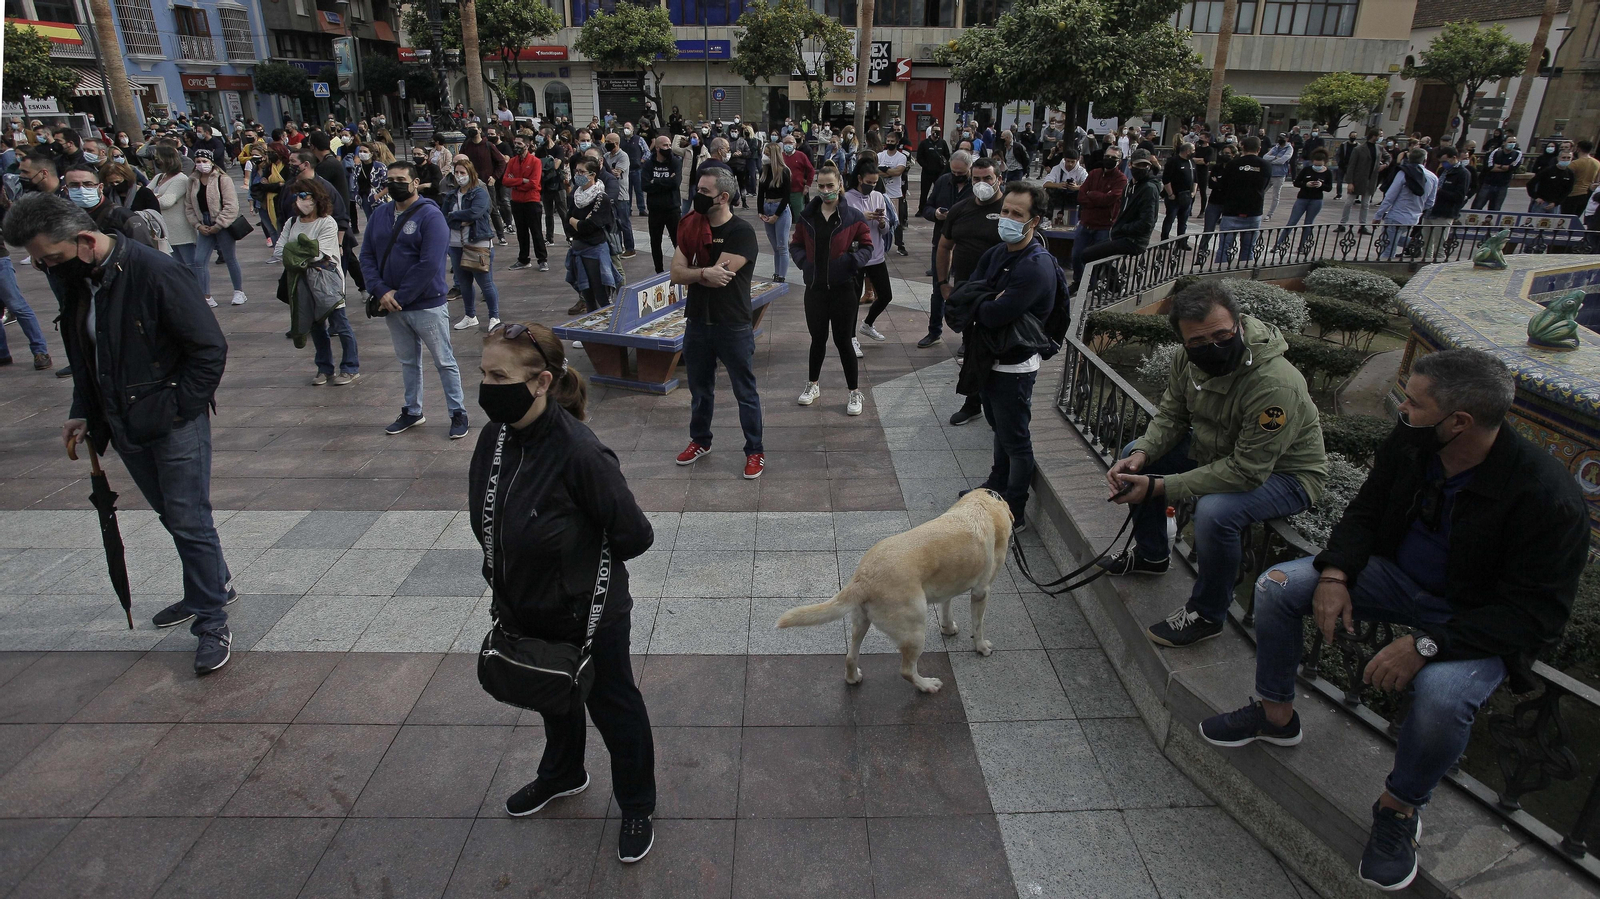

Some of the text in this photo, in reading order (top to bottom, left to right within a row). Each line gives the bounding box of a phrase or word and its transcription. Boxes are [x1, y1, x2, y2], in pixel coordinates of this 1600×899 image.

[871, 43, 888, 58] EX
[870, 59, 888, 71] HOP
[485, 474, 498, 511] LOLA
[595, 559, 610, 596] LOLA
